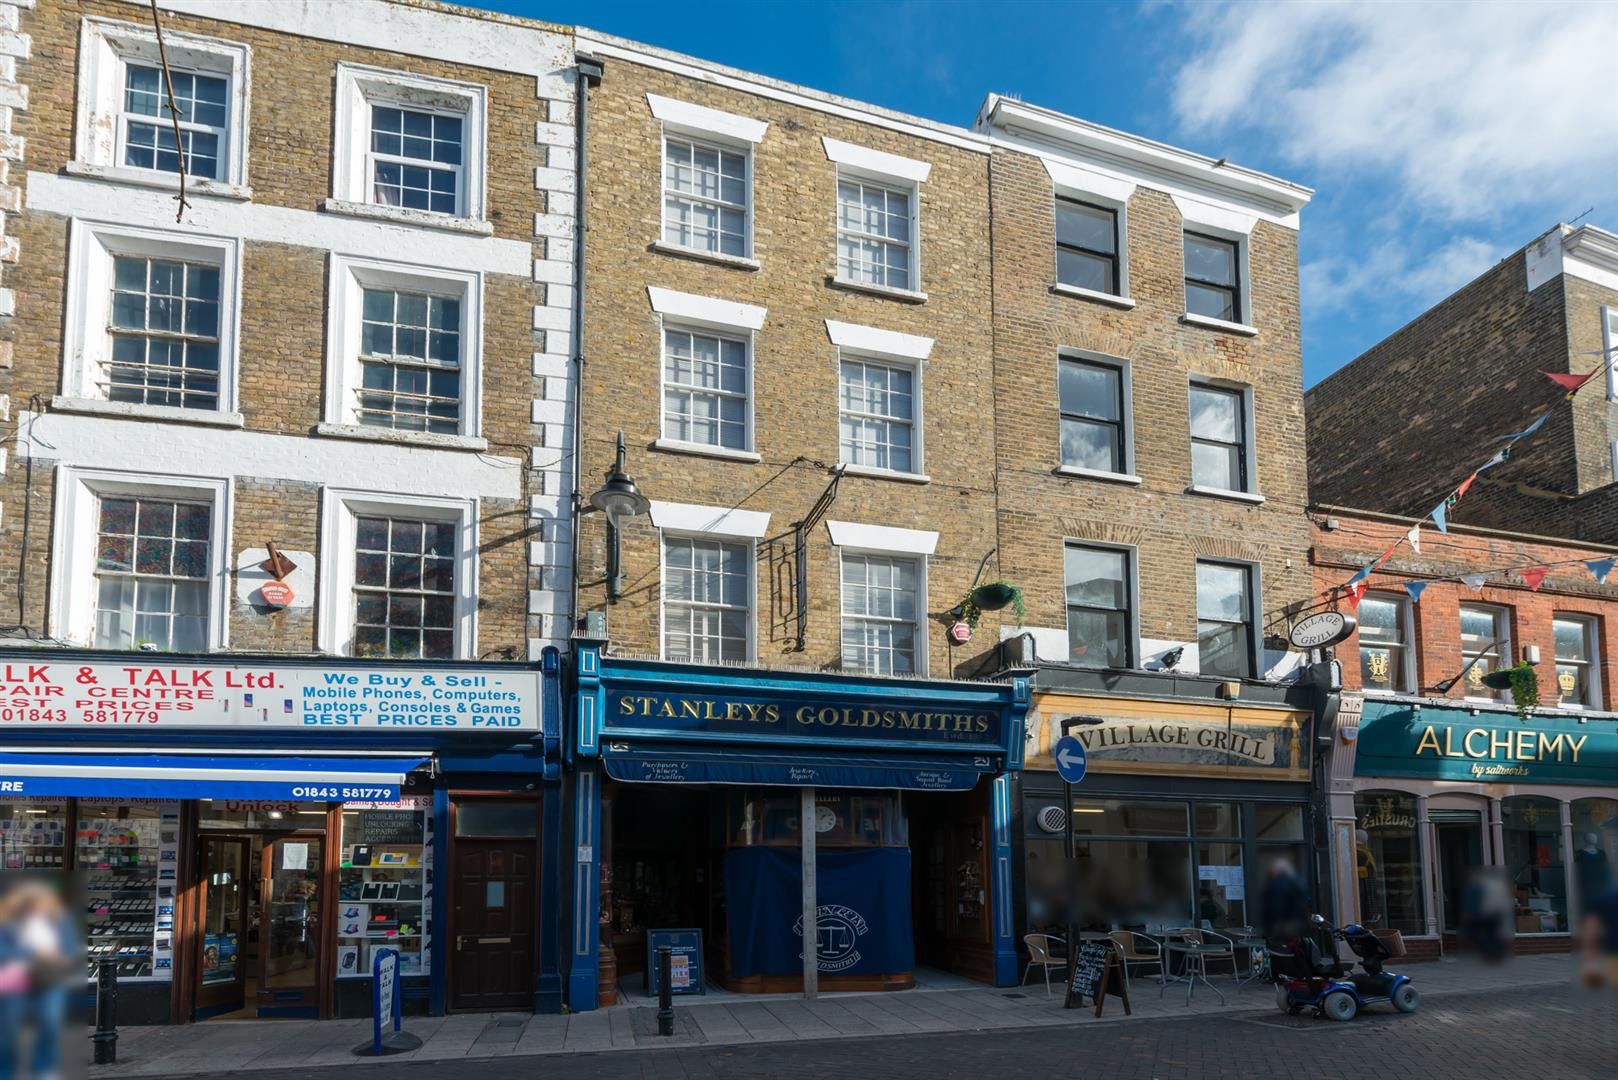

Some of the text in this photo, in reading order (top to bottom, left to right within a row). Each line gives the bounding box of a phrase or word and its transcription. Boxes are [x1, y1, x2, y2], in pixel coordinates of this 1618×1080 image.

[1294, 614, 1340, 636] VILLAGE
[1301, 631, 1334, 644] GRILL
[0, 665, 284, 688] LK & TALK Ltd.
[324, 673, 359, 685] We
[369, 674, 412, 688] Buy
[421, 675, 436, 686] &
[445, 675, 486, 687] Sell
[88, 687, 214, 700] CENTRE
[303, 687, 521, 702] Mobile Phones, Computers,
[76, 700, 194, 711] PRICES
[303, 701, 521, 714] Laptops, Consoles & Games
[2, 709, 159, 723] 01843 581779
[303, 714, 521, 727] BEST PRICES PAID
[620, 696, 988, 732] STANLEYS GOLDSMITHS
[1077, 725, 1266, 760] VILLAGE GRILL
[1416, 725, 1588, 763] ALCHEMY
[1471, 763, 1530, 778] by saltworks
[0, 781, 24, 792] RE
[292, 787, 391, 799] 01843 581779
[225, 800, 299, 812] Unlock
